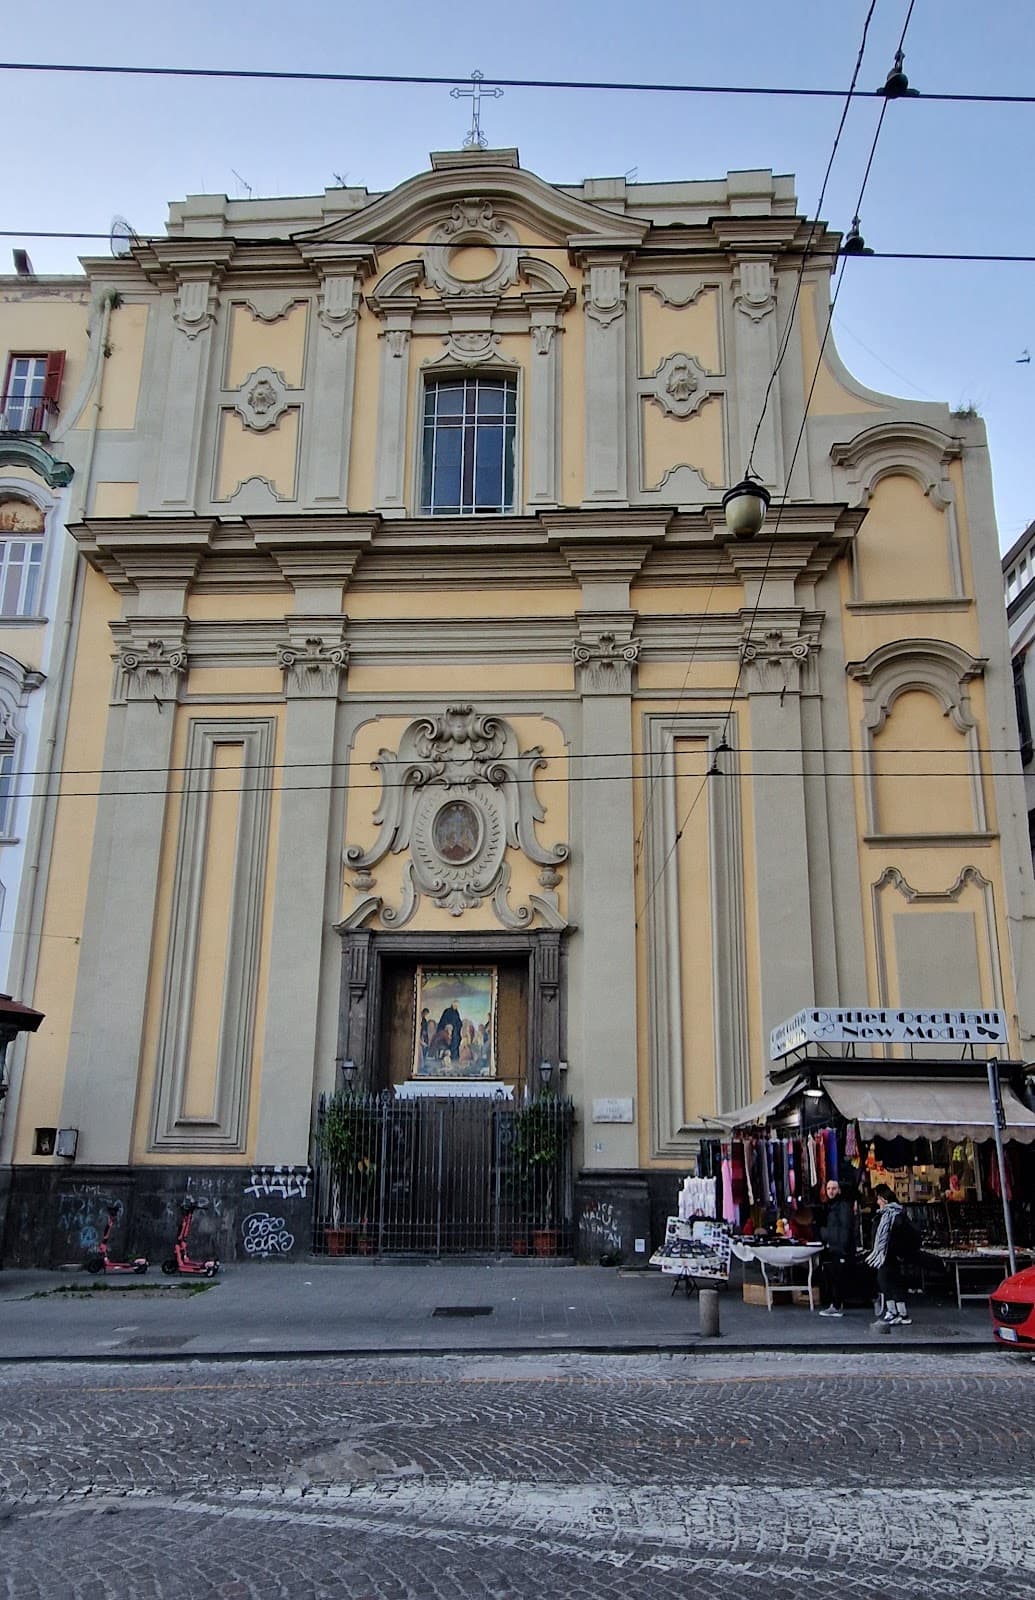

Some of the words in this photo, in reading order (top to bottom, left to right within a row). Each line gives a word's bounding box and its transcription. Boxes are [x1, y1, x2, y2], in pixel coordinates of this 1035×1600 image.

[811, 1011, 887, 1023] Outlet
[896, 1012, 1000, 1024] Occhiali
[842, 1026, 895, 1039] New
[903, 1026, 970, 1039] Moda
